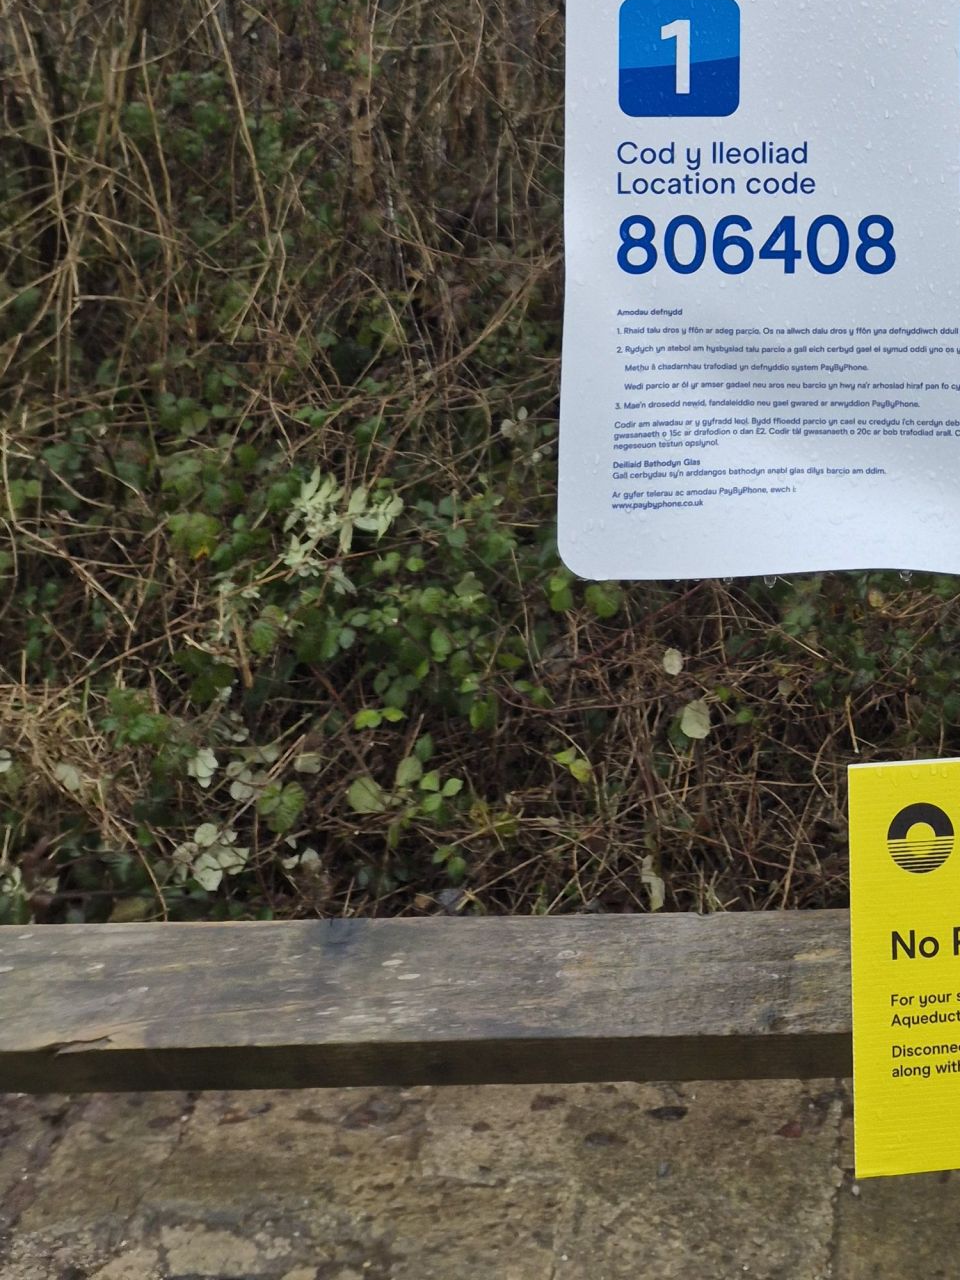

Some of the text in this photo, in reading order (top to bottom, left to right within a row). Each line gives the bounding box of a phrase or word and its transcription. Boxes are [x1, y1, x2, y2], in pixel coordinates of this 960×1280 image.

[661, 20, 690, 93] 1
[618, 142, 807, 170] Cod y lleoliad
[618, 172, 815, 194] Location code
[617, 215, 896, 274] 806408
[650, 308, 683, 317] defnydd
[892, 930, 939, 960] No
[891, 994, 914, 1006] For
[920, 994, 951, 1007] your
[892, 1011, 960, 1028] Aqueduct
[893, 1065, 930, 1078] along
